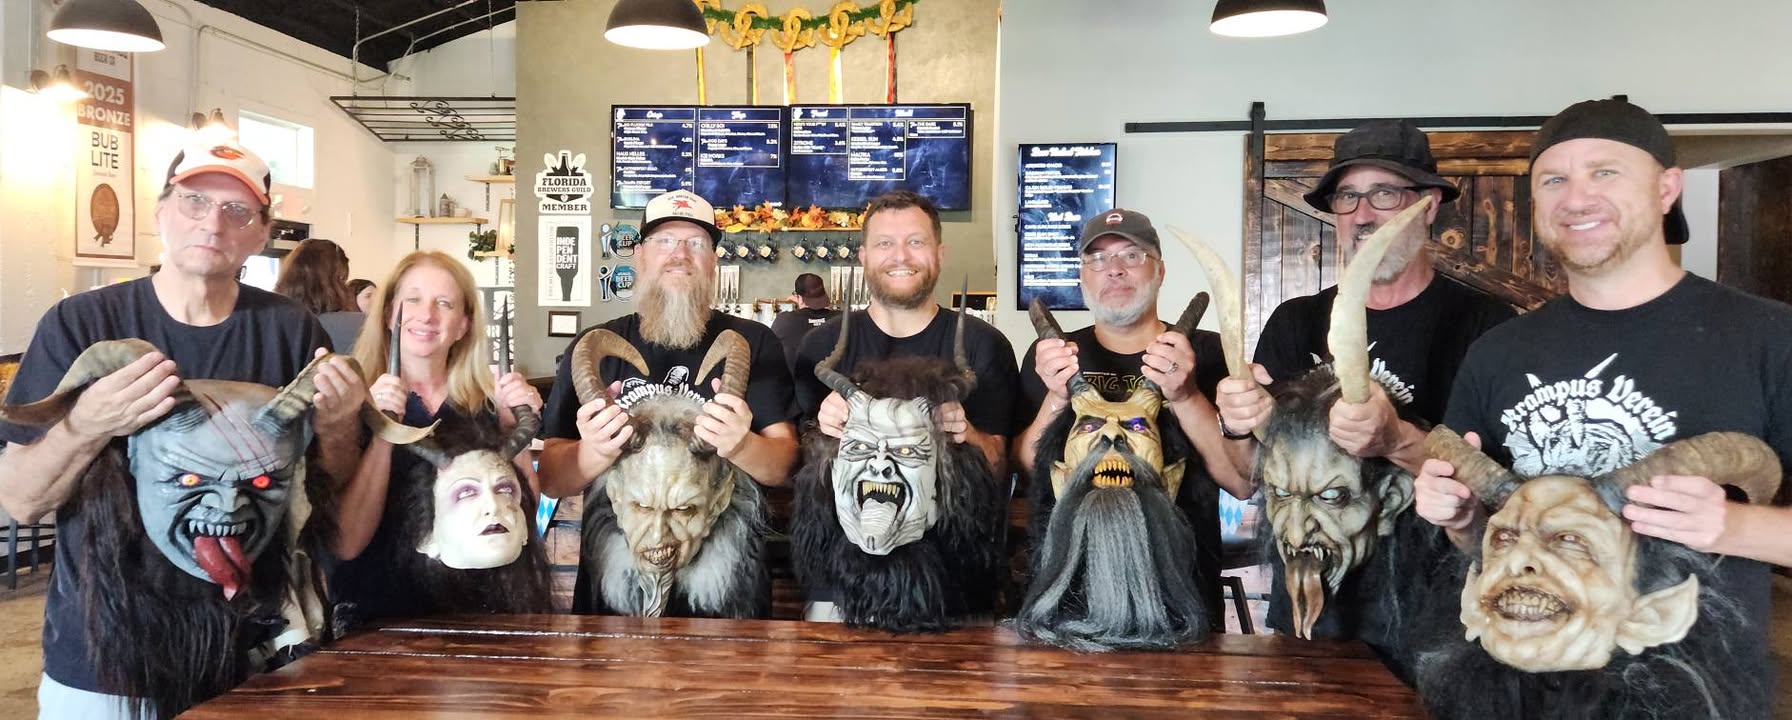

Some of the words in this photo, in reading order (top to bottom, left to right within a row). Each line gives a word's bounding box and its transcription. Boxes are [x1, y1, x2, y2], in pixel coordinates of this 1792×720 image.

[84, 80, 125, 105] 2025
[77, 103, 131, 127] BRONZE
[92, 131, 119, 150] BUB
[91, 151, 119, 169] LITE
[542, 178, 587, 187] FLORIDA
[542, 203, 587, 211] MEMBER
[556, 236, 576, 246] INDE
[556, 246, 574, 256] PEN
[556, 255, 578, 265] DENT
[556, 263, 577, 271] CRAFT
[617, 281, 632, 289] CUP
[1370, 357, 1415, 405] Verein
[1500, 379, 1604, 433] Krampus
[1605, 375, 1678, 442] Verein
